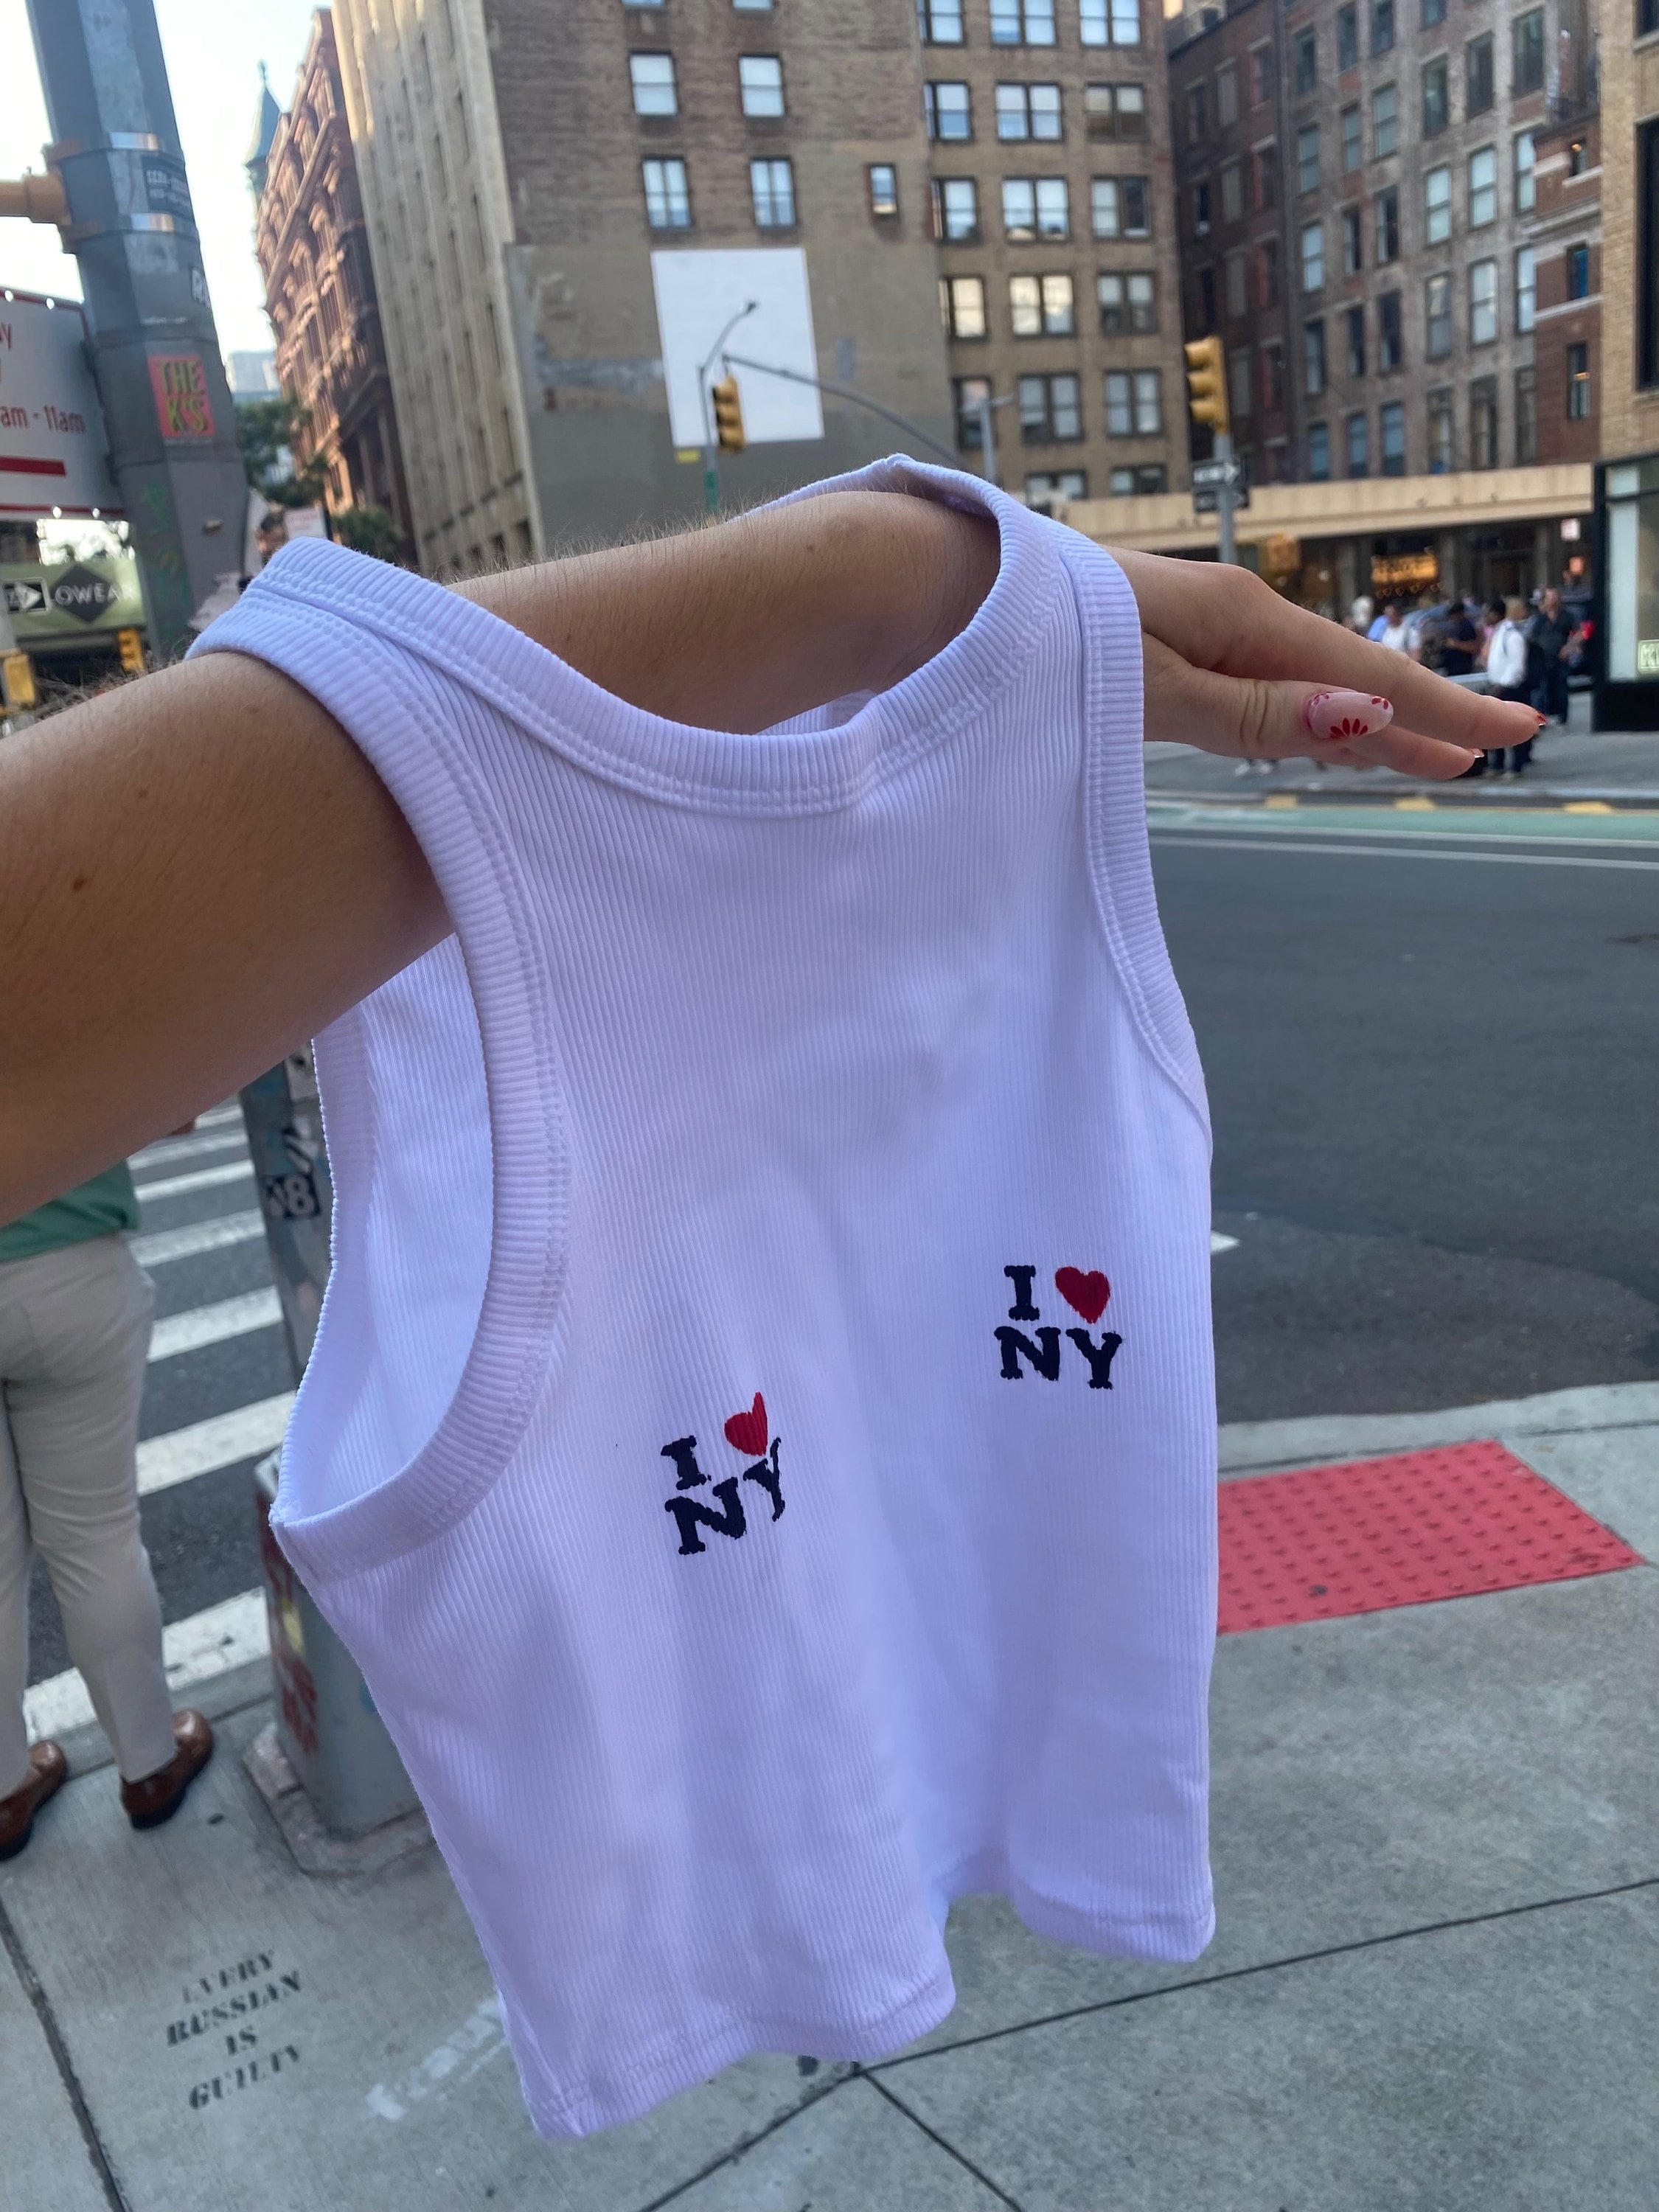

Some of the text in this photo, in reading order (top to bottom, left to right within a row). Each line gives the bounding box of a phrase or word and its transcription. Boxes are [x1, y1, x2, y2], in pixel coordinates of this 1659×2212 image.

[159, 360, 204, 396] THE
[44, 405, 86, 434] 11am
[50, 580, 134, 605] OWEAR
[1004, 1265, 1040, 1321] I
[994, 1326, 1122, 1390] NY
[661, 1435, 707, 1490] I
[664, 1437, 785, 1555] NY
[167, 1970, 301, 2047] RUSSIAN
[226, 2025, 256, 2056] IS
[189, 2045, 299, 2109] GUILTY
